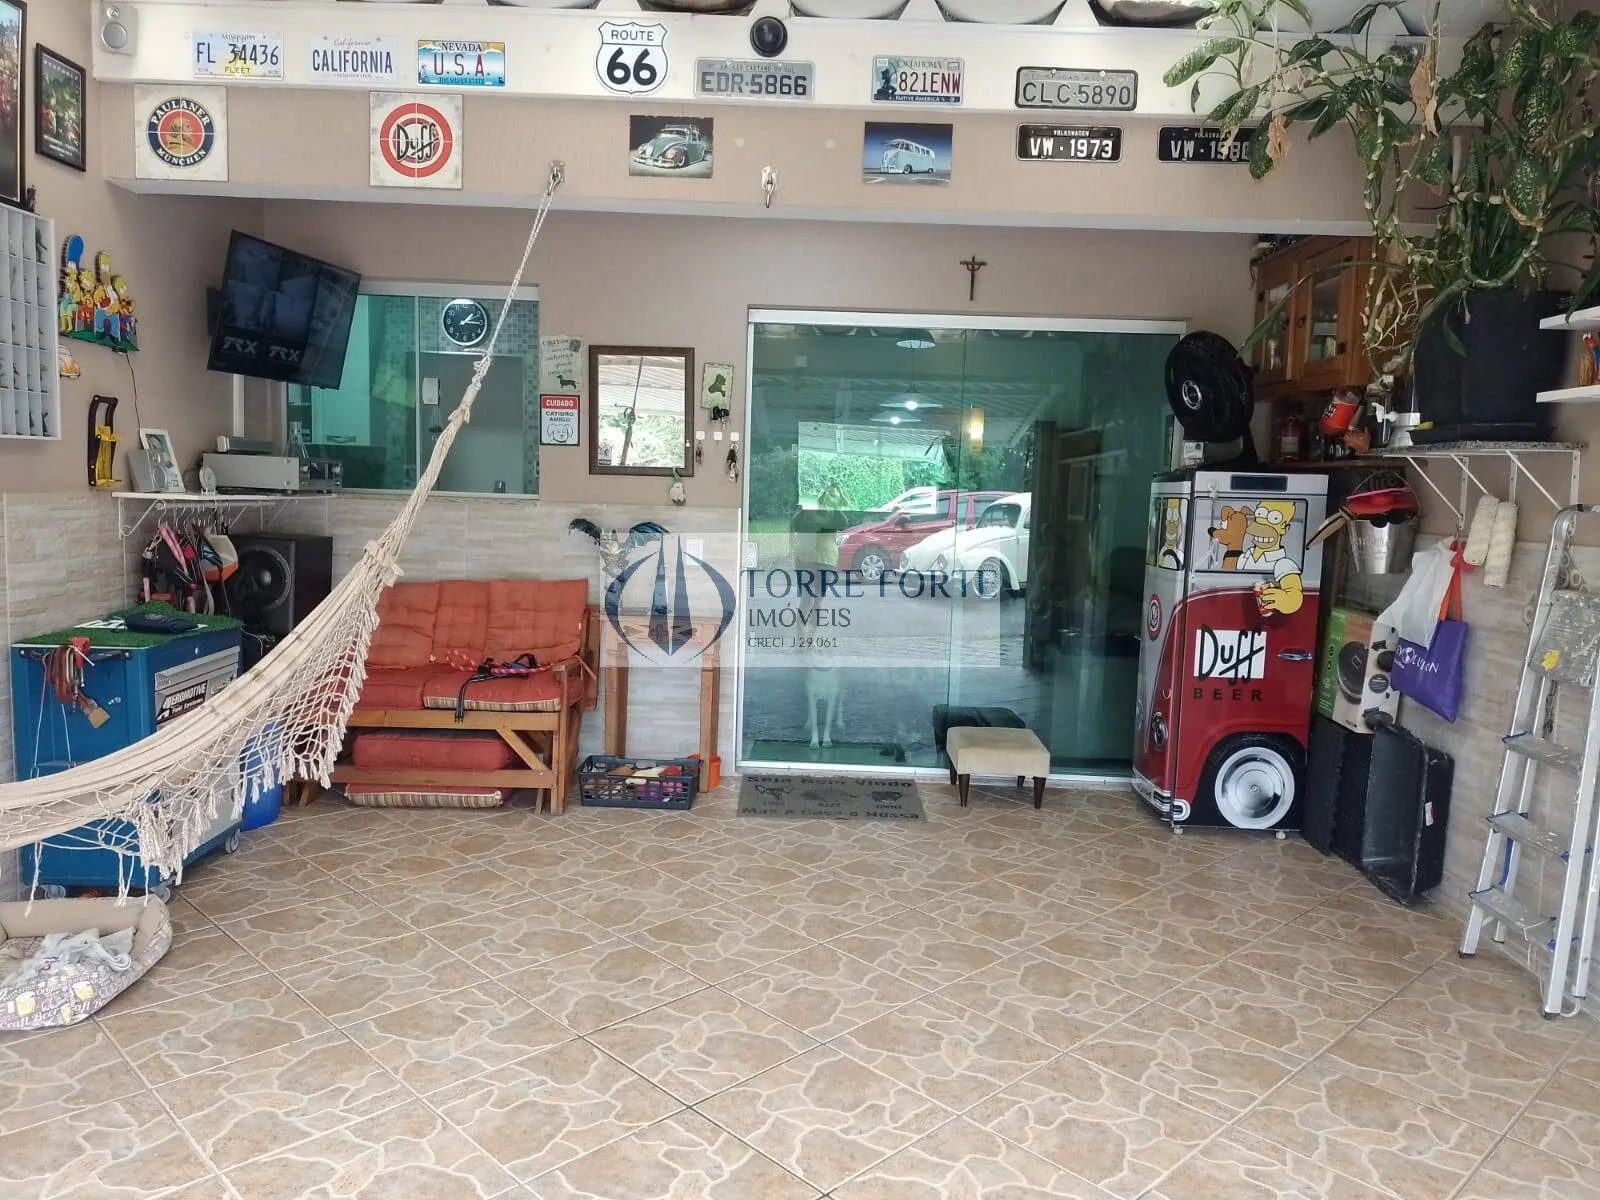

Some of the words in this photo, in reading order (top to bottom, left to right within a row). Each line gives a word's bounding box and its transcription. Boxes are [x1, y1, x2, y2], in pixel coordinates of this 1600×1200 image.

[610, 29, 655, 42] ROUTE
[196, 42, 216, 64] FL
[228, 43, 279, 65] 34436
[442, 42, 482, 52] NEVADA
[224, 66, 251, 74] FLEET
[312, 49, 393, 74] CALIFORNIA
[606, 46, 658, 86] 66
[899, 71, 961, 93] 821ENW
[150, 99, 211, 126] PAULANER
[396, 122, 440, 162] Duff
[1053, 129, 1090, 137] VOLKSWAGEN
[1030, 138, 1054, 157] VW
[1070, 138, 1113, 158] 1973
[1170, 140, 1195, 159] VW
[545, 399, 574, 407] CUIDADO
[1199, 625, 1265, 686] Duff
[1194, 687, 1262, 702] BEER
